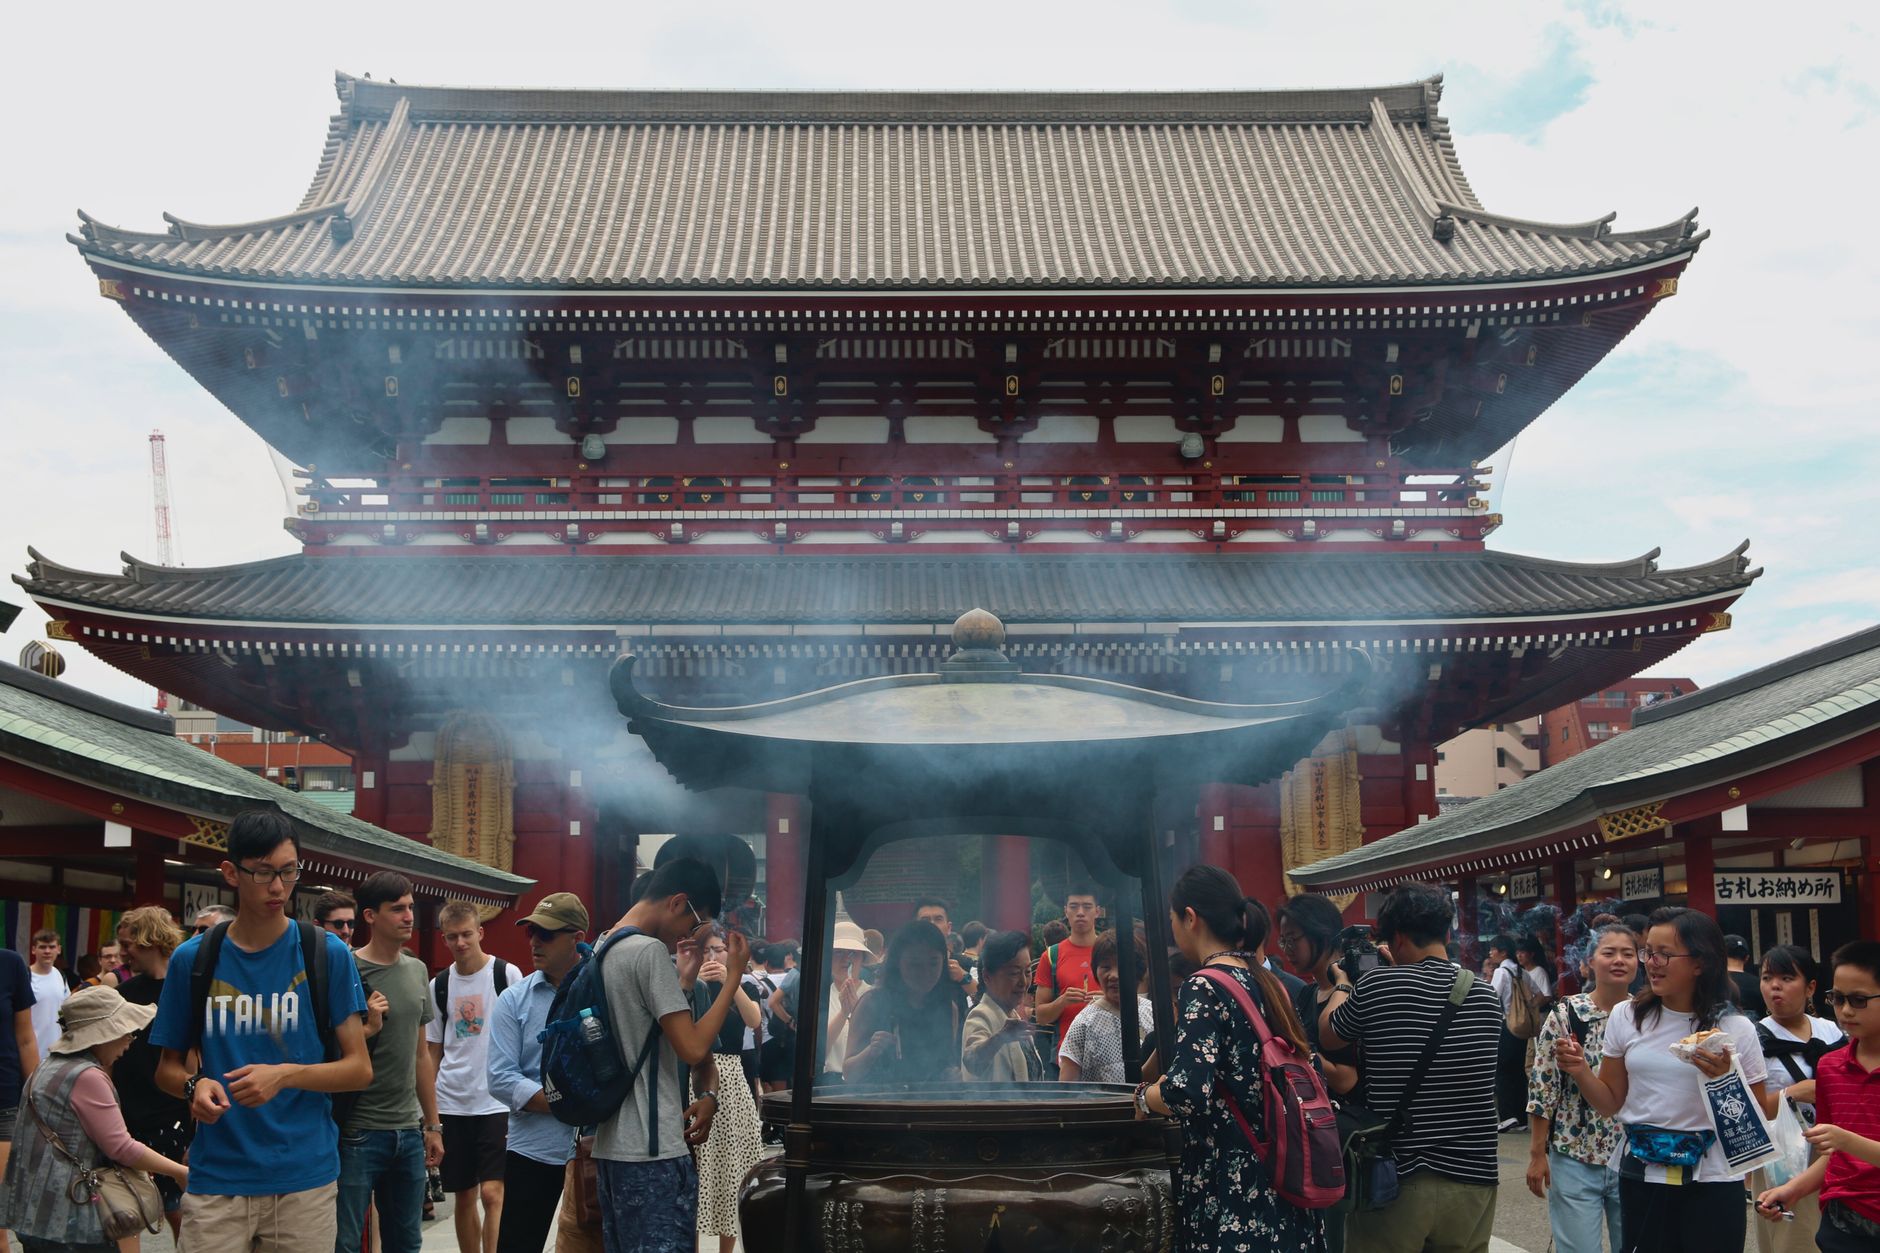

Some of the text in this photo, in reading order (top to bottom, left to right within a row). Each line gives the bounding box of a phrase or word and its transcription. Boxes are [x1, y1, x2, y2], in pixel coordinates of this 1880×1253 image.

[1715, 876, 1835, 899] 古札お納め所
[205, 991, 299, 1039] ITALIA
